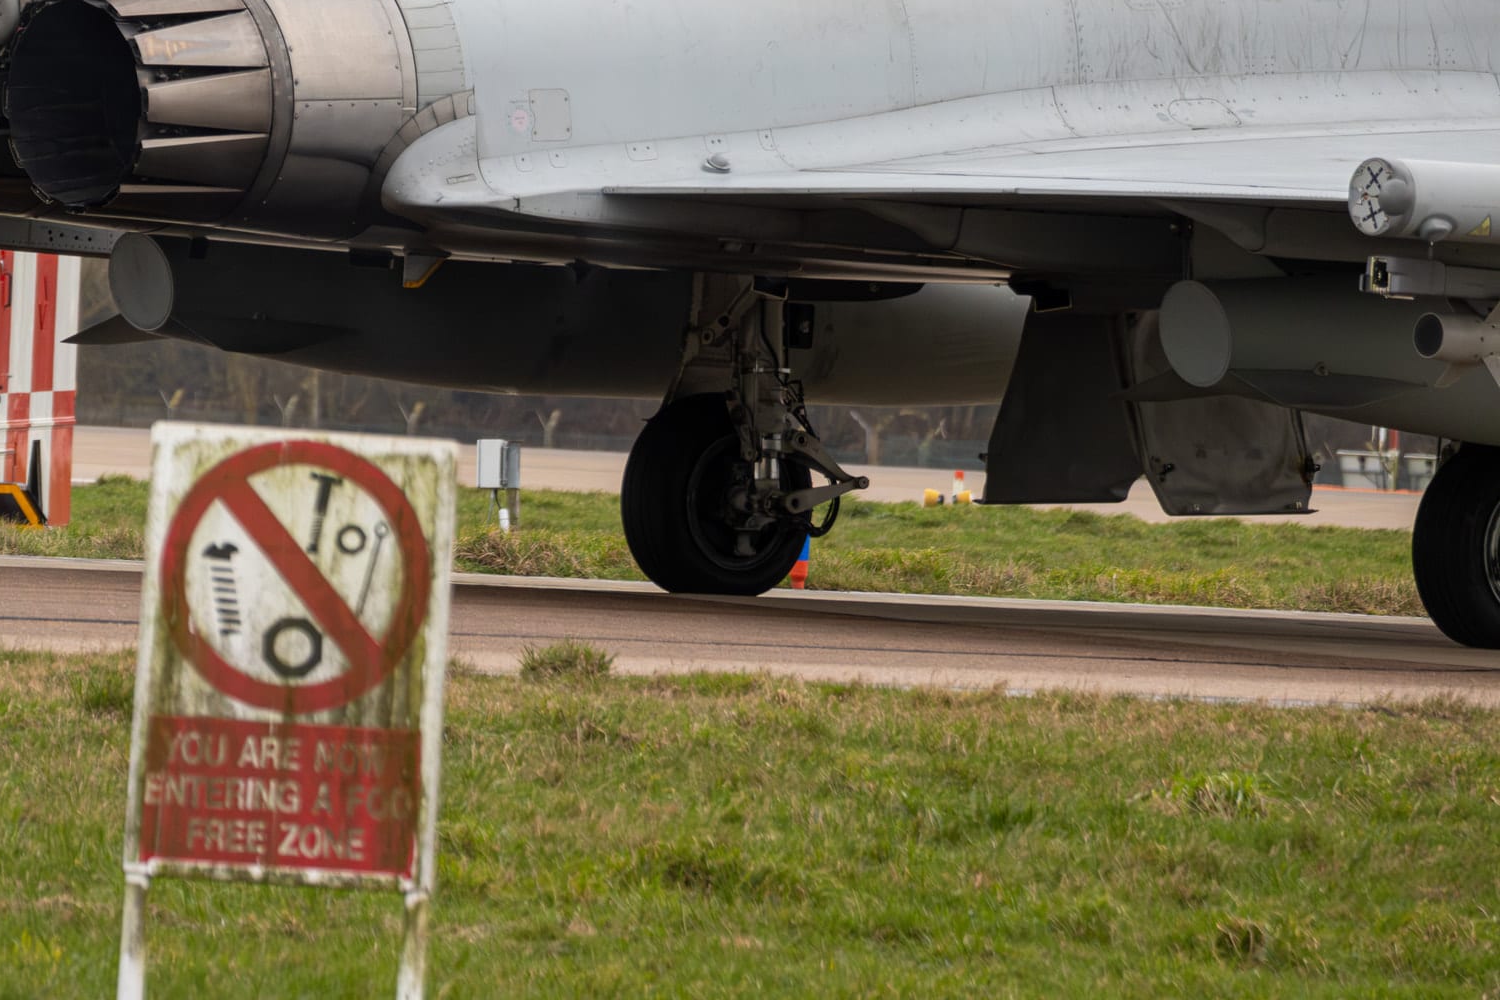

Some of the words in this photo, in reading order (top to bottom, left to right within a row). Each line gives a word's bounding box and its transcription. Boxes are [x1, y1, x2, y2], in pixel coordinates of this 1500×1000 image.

[163, 730, 227, 767] YOU
[237, 735, 302, 771] ARE
[144, 772, 299, 814] ENTERING
[312, 783, 332, 816] A
[187, 817, 266, 854] FREE
[277, 822, 365, 861] ZONE
